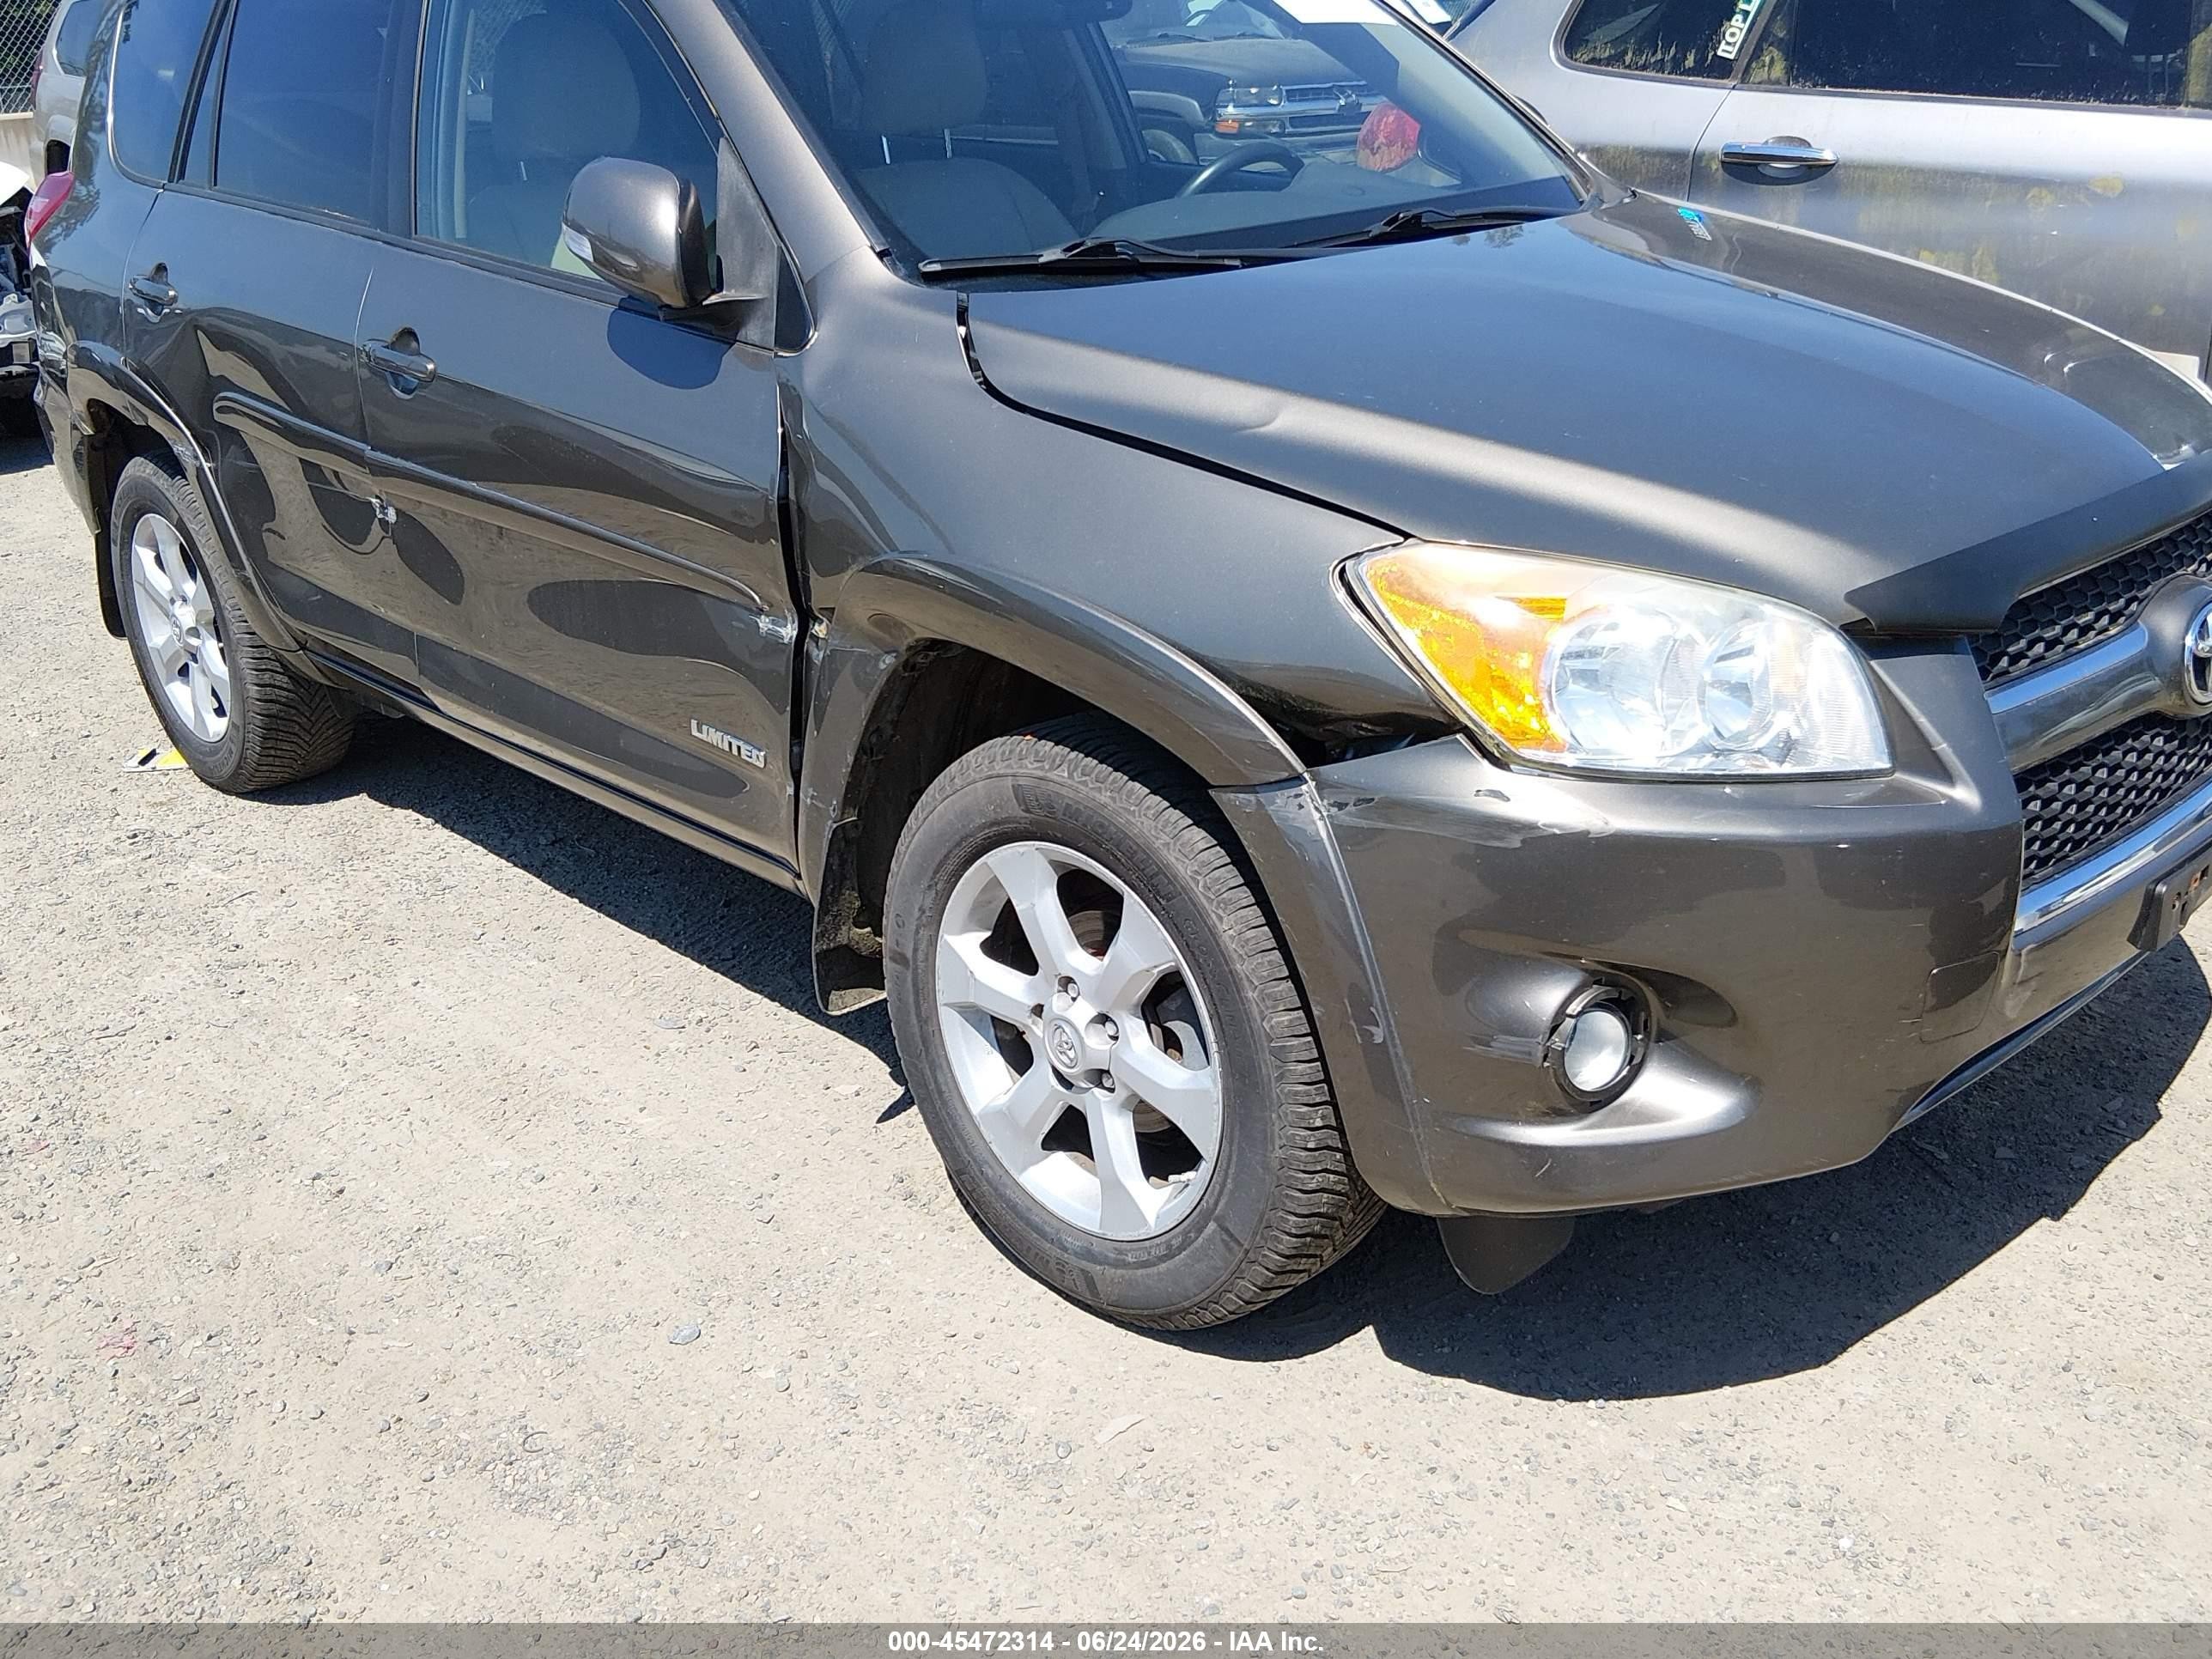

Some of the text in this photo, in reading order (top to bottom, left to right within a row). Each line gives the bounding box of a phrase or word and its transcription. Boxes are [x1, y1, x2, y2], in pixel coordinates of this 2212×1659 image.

[1718, 14, 1745, 54] TOP
[690, 719, 766, 769] LIMITED
[1059, 799, 1182, 902] MICHELIN
